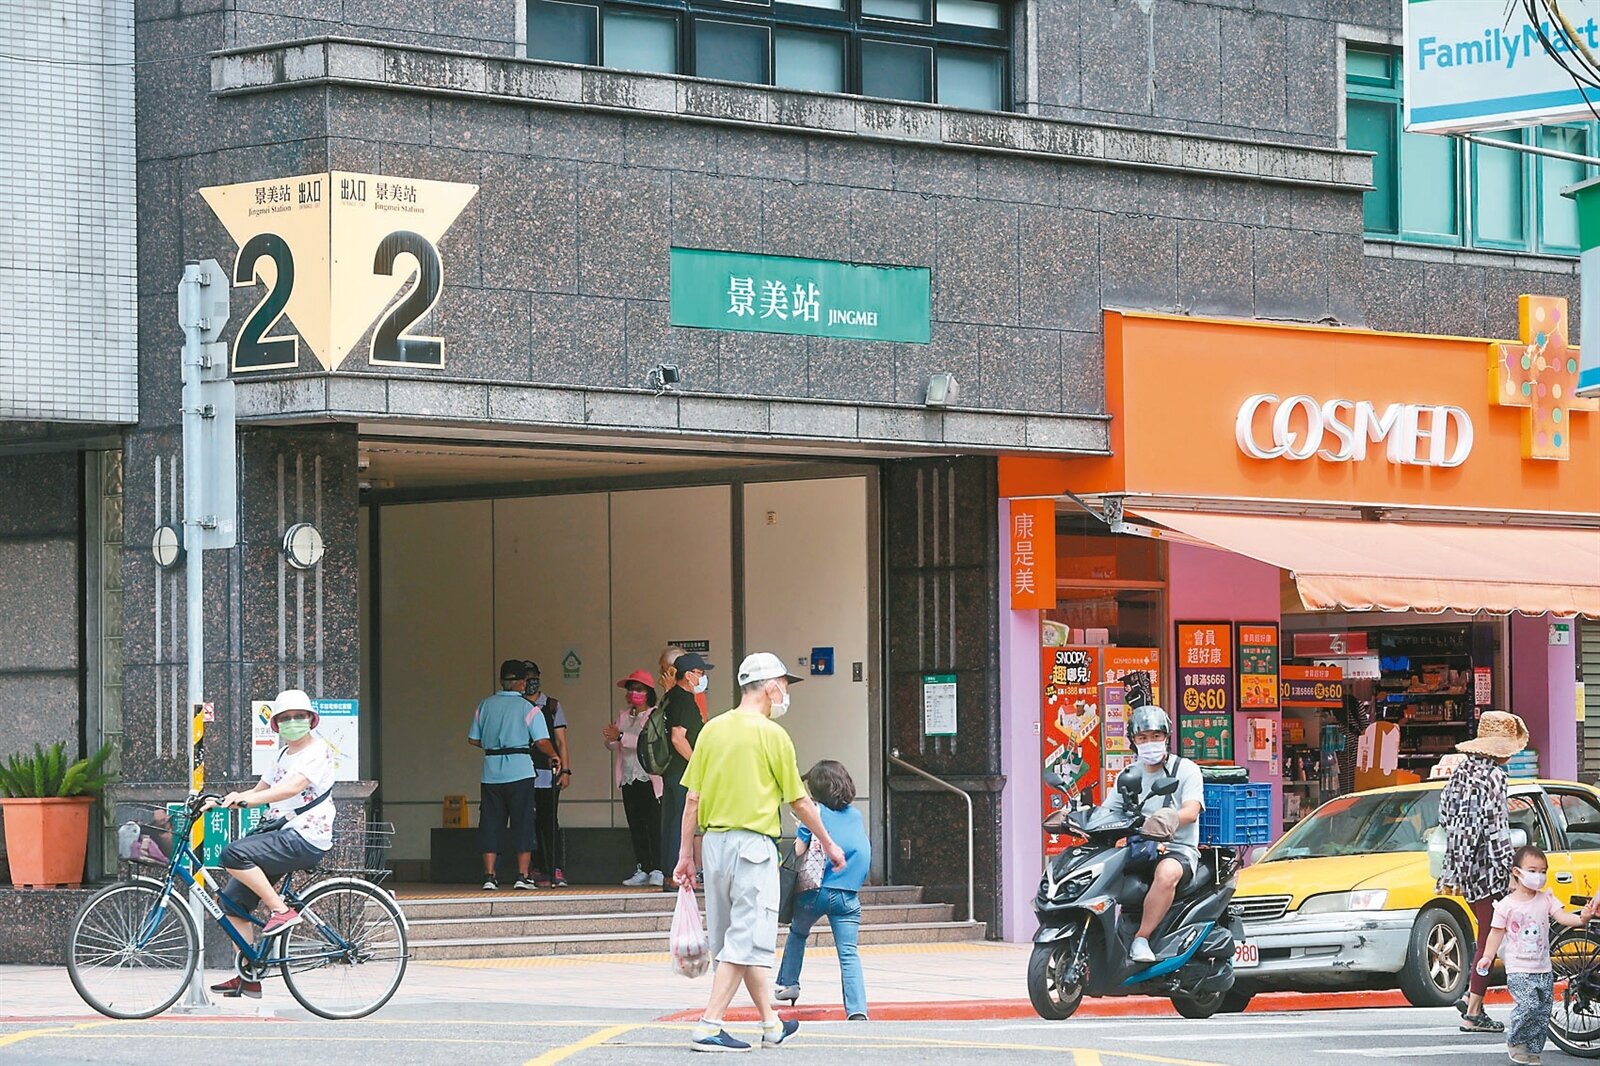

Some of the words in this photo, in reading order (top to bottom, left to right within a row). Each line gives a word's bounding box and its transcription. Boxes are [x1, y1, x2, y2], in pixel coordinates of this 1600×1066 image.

[254, 184, 291, 205] 景美站
[298, 180, 321, 204] 出入口
[341, 178, 366, 201] 出入口
[376, 182, 417, 203] 景美站
[248, 206, 271, 217] Jingmei
[271, 204, 292, 214] Station
[374, 202, 399, 213] Jingmei
[401, 205, 425, 214] Station
[233, 232, 297, 369] 2
[372, 230, 442, 367] 2
[727, 275, 821, 322] 景美站
[827, 309, 878, 327] JINGMEI
[1235, 393, 1474, 467] COSMED
[1014, 512, 1035, 595] 康是美
[1193, 629, 1216, 646] 會員
[1056, 651, 1087, 664] SNOOPY
[1187, 647, 1222, 664] 超好康
[1105, 669, 1157, 684] 會員康
[1184, 674, 1226, 686] 會員滿$666
[1435, 767, 1453, 776] TA
[174, 810, 224, 834] 景街
[1235, 945, 1257, 962] 980
